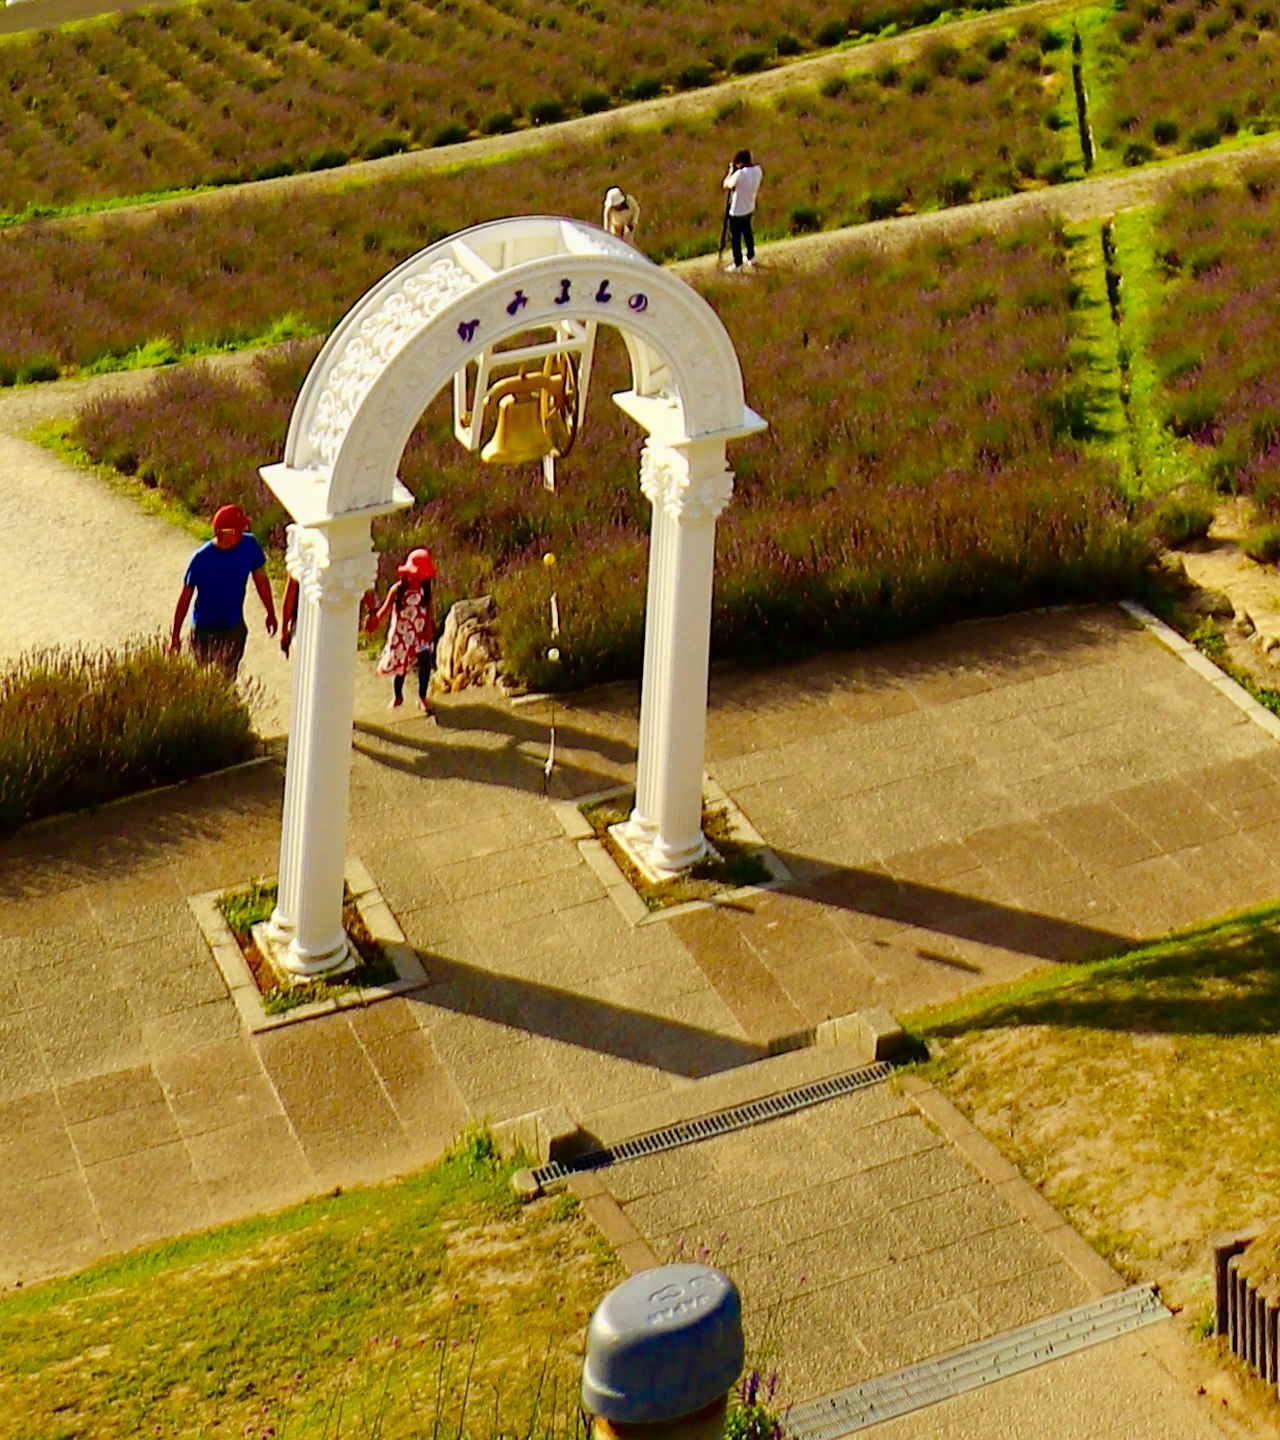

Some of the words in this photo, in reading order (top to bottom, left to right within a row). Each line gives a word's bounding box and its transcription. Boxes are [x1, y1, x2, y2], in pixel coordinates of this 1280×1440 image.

[457, 278, 648, 343] かみふらの
